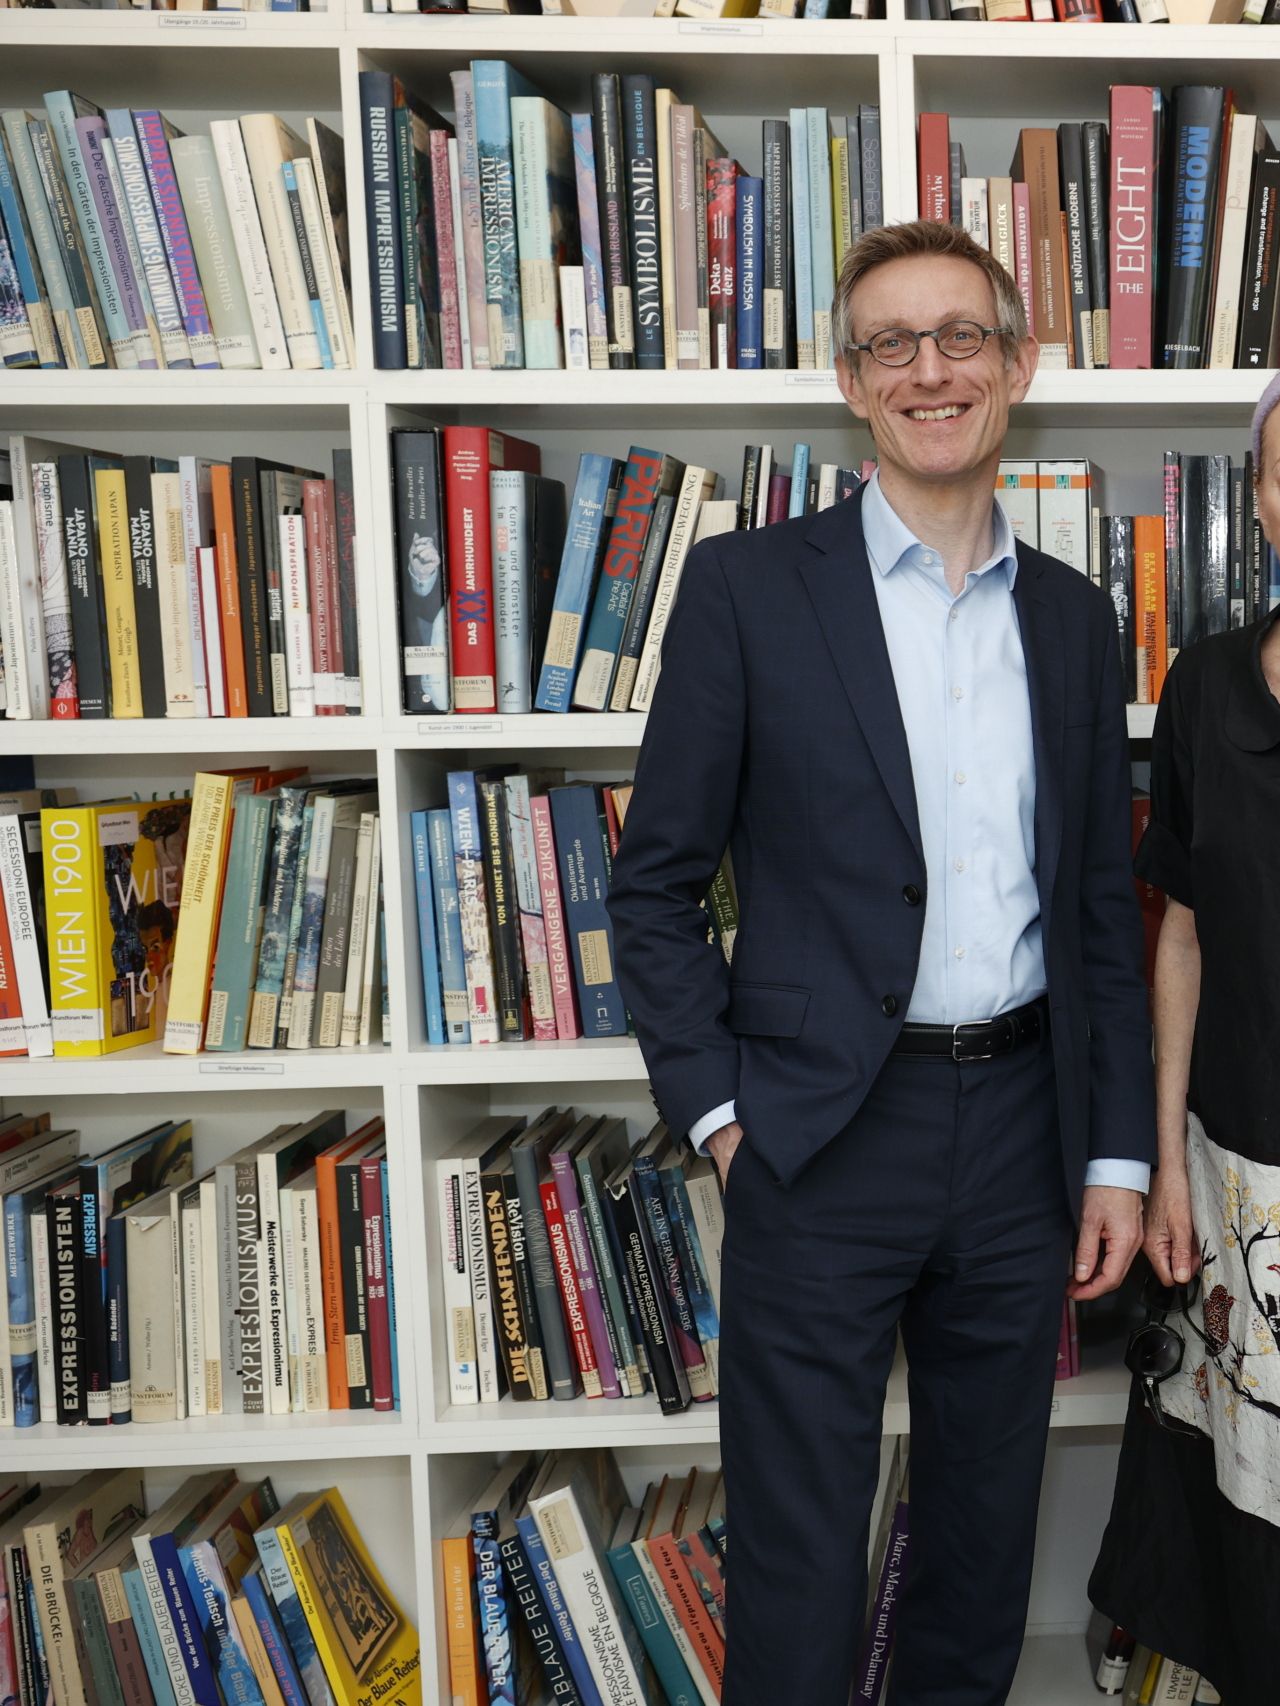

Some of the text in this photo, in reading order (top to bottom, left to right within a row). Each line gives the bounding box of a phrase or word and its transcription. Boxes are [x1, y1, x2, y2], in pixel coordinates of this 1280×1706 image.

[461, 91, 475, 129] Belgique
[635, 90, 644, 138] BELGIQUE
[637, 142, 645, 154] EN
[92, 153, 105, 172] Der
[400, 126, 408, 177] IMPRESSIONIST
[461, 141, 479, 218] Symbolisme
[679, 148, 687, 158] de
[679, 163, 691, 211] Splendeurs
[41, 133, 76, 250] The Impressionist and the City
[96, 175, 117, 215] deutsche
[145, 115, 205, 317] IMPRESSIONISTINNEN
[290, 198, 303, 237] AMERICAN
[370, 107, 398, 331] RUSSIAN IMPRESSIONISM
[481, 156, 514, 299] AMERICAN IMPRESSIONISM
[772, 142, 781, 287] IMPRESSIONISM TO SYMBOLISM
[1116, 157, 1146, 273] EIGHT
[1181, 126, 1210, 268] MODERN
[67, 148, 119, 315] In den Gärten der Impressionisten
[106, 218, 132, 293] Impressionismus
[114, 137, 182, 328] STIMMUNGSIMPRESSIONISMUS
[191, 177, 233, 311] Impressionismus
[296, 238, 316, 293] IMPRESSIONISM
[631, 158, 660, 326] SYMBOLISME
[743, 195, 753, 310] SYMBOLISM IN RUSSIA
[997, 203, 1009, 263] ZUM GLÜCK
[1068, 182, 1084, 294] DIE NÜTZLICHE MODERNE
[1117, 283, 1143, 294] THE
[39, 468, 56, 527] Japonisme
[71, 507, 87, 557] JAPANO
[108, 490, 123, 580] INSPIRATION JAPAN
[136, 507, 151, 557] JAPANO
[603, 453, 662, 579] PARIS
[63, 517, 76, 558] MANIA
[127, 517, 140, 558] MANIA
[288, 516, 299, 608] NIPPONSPIRATION
[508, 506, 521, 638] Kunst und Künstler
[649, 473, 698, 647] KUNSTGEWERBEBEWEGUNG
[268, 588, 281, 620] yesterday
[457, 507, 486, 645] DAS XX JAHRHUNDERT
[606, 580, 623, 612] the Arts
[615, 583, 632, 610] Capital
[194, 787, 225, 903] DER PREIS DER SCHÖNHEIT
[487, 794, 507, 925] VON MONET BIS MONDRIAN
[566, 854, 578, 902] Okkultismus
[573, 839, 588, 901] und Avantgarde
[5, 826, 33, 941] SECESSIONI EUROPEE
[50, 820, 88, 1000] WIEN 1900
[535, 807, 568, 994] VERGANGENE ZUKUNFT
[580, 935, 592, 983] KUNSTFORUM
[82, 1194, 97, 1255] EXPRESSIV
[504, 1198, 524, 1261] ReVision
[566, 1210, 586, 1271] Expressionismus
[579, 1175, 611, 1278] Österreichischer Expressionismus
[648, 1196, 661, 1217] ART
[654, 1219, 665, 1230] IN
[6, 1213, 17, 1278] MEISTERWERKE
[551, 1223, 584, 1332] EXPRESSIONISMUS
[656, 1231, 678, 1284] GERMANY
[55, 1207, 80, 1410] EXPRESSIONISTEN
[237, 1193, 262, 1394] EXPRESIONISMUS
[266, 1221, 284, 1386] Meisterwerke des Expressionismus
[485, 1189, 528, 1382] DIE SCHAFFENDEN
[624, 1251, 649, 1331] Primitivism and Modernity
[627, 1232, 661, 1345] GERMAN EXPRESSIONISM
[142, 1559, 163, 1604] REITER
[479, 1552, 495, 1580] DER
[538, 1561, 574, 1642] Der Blaue Reiter
[583, 1568, 609, 1623] BELGIQUE
[156, 1605, 175, 1646] BLAUER
[501, 1540, 570, 1696] BLAUE REITER
[601, 1624, 614, 1642] EN
[860, 1532, 909, 1700] Marc, Macke und Delaunay
